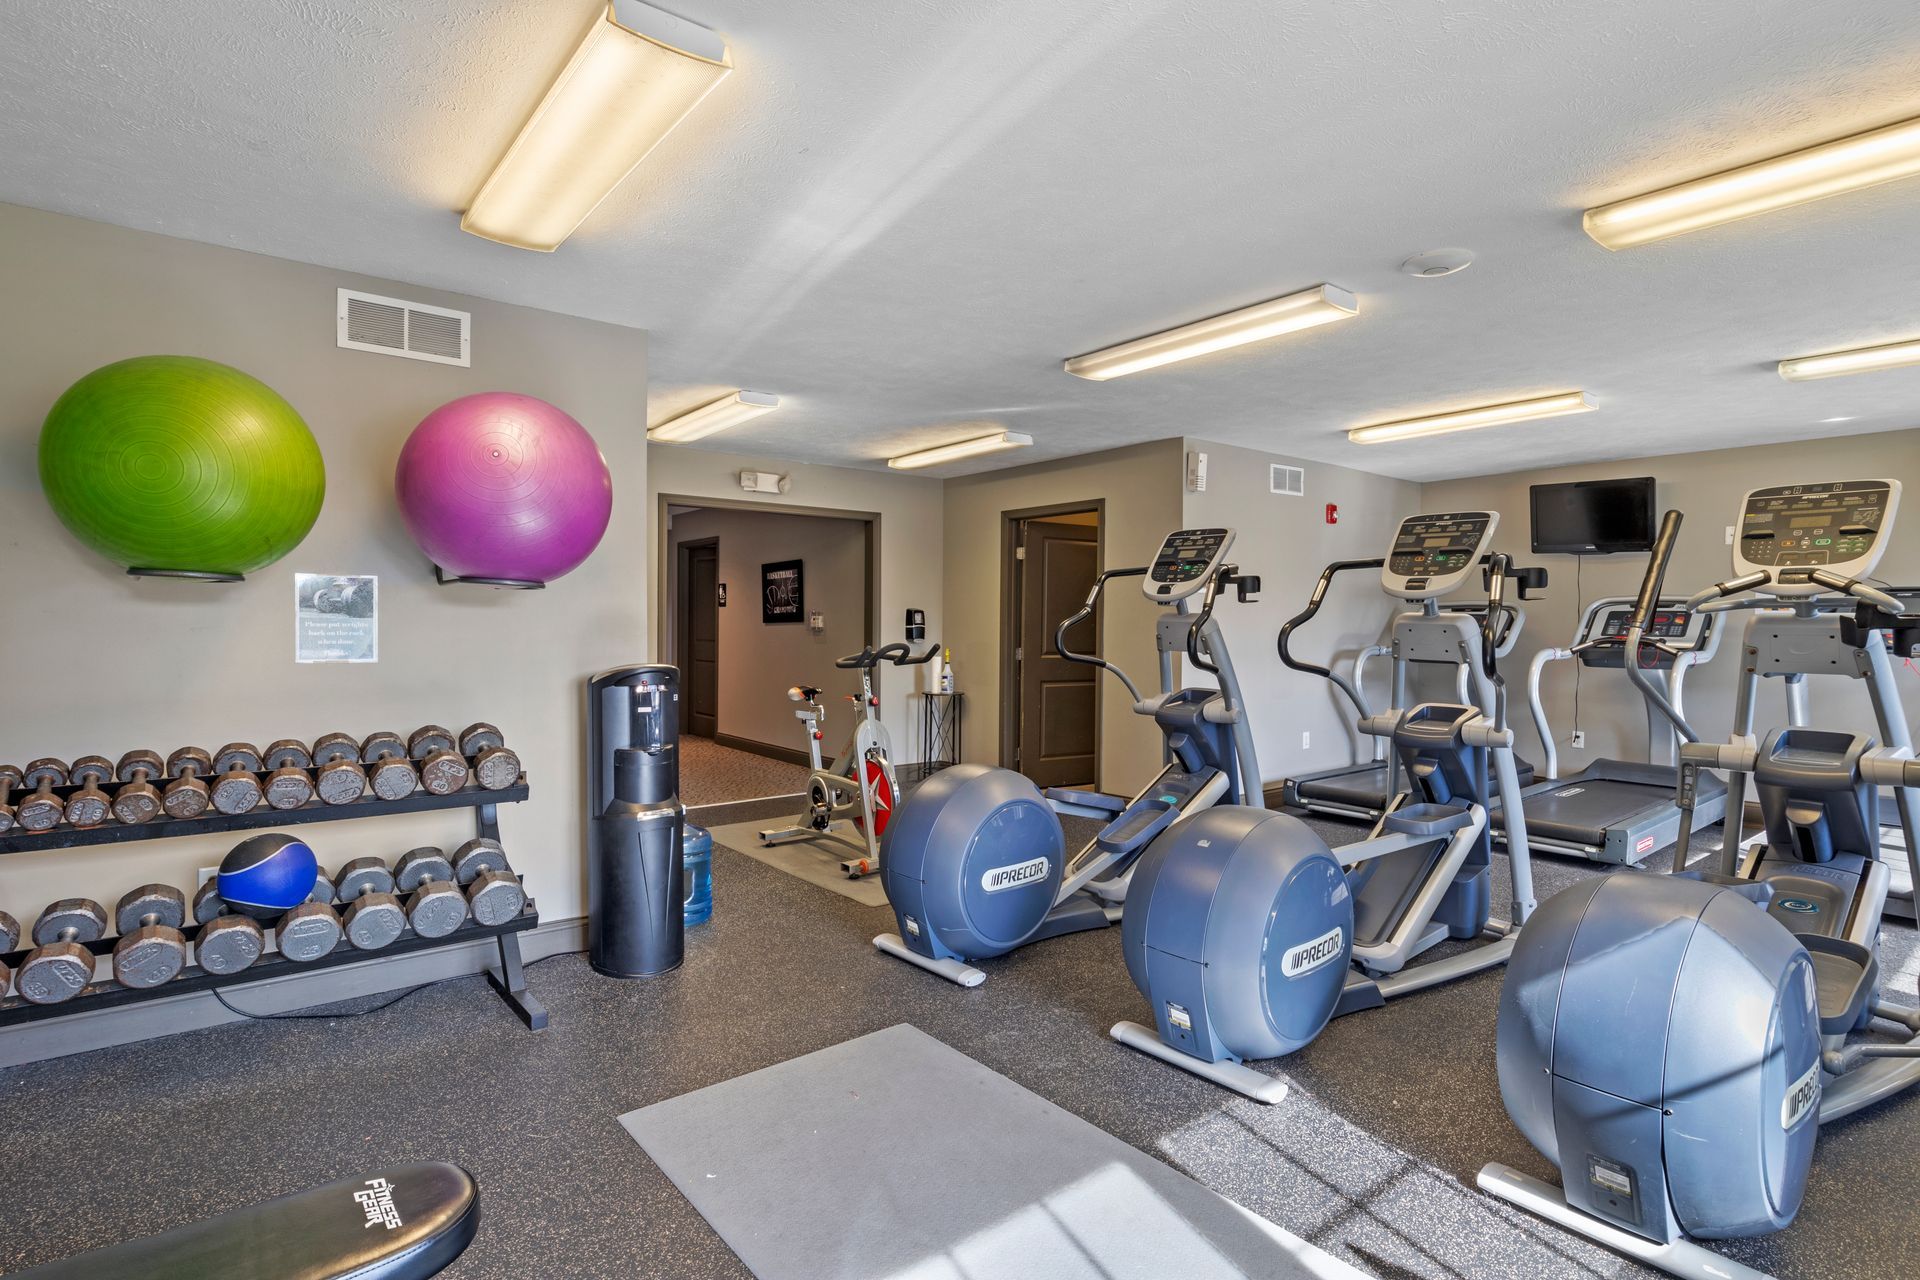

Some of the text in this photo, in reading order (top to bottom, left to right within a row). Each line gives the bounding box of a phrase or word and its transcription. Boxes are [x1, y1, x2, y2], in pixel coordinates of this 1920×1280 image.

[432, 780, 447, 792] 30
[1000, 861, 1044, 886] PRECOR
[1299, 933, 1340, 967] PRECOR
[353, 1189, 384, 1229] GEAR
[365, 1178, 403, 1230] FITNESS
